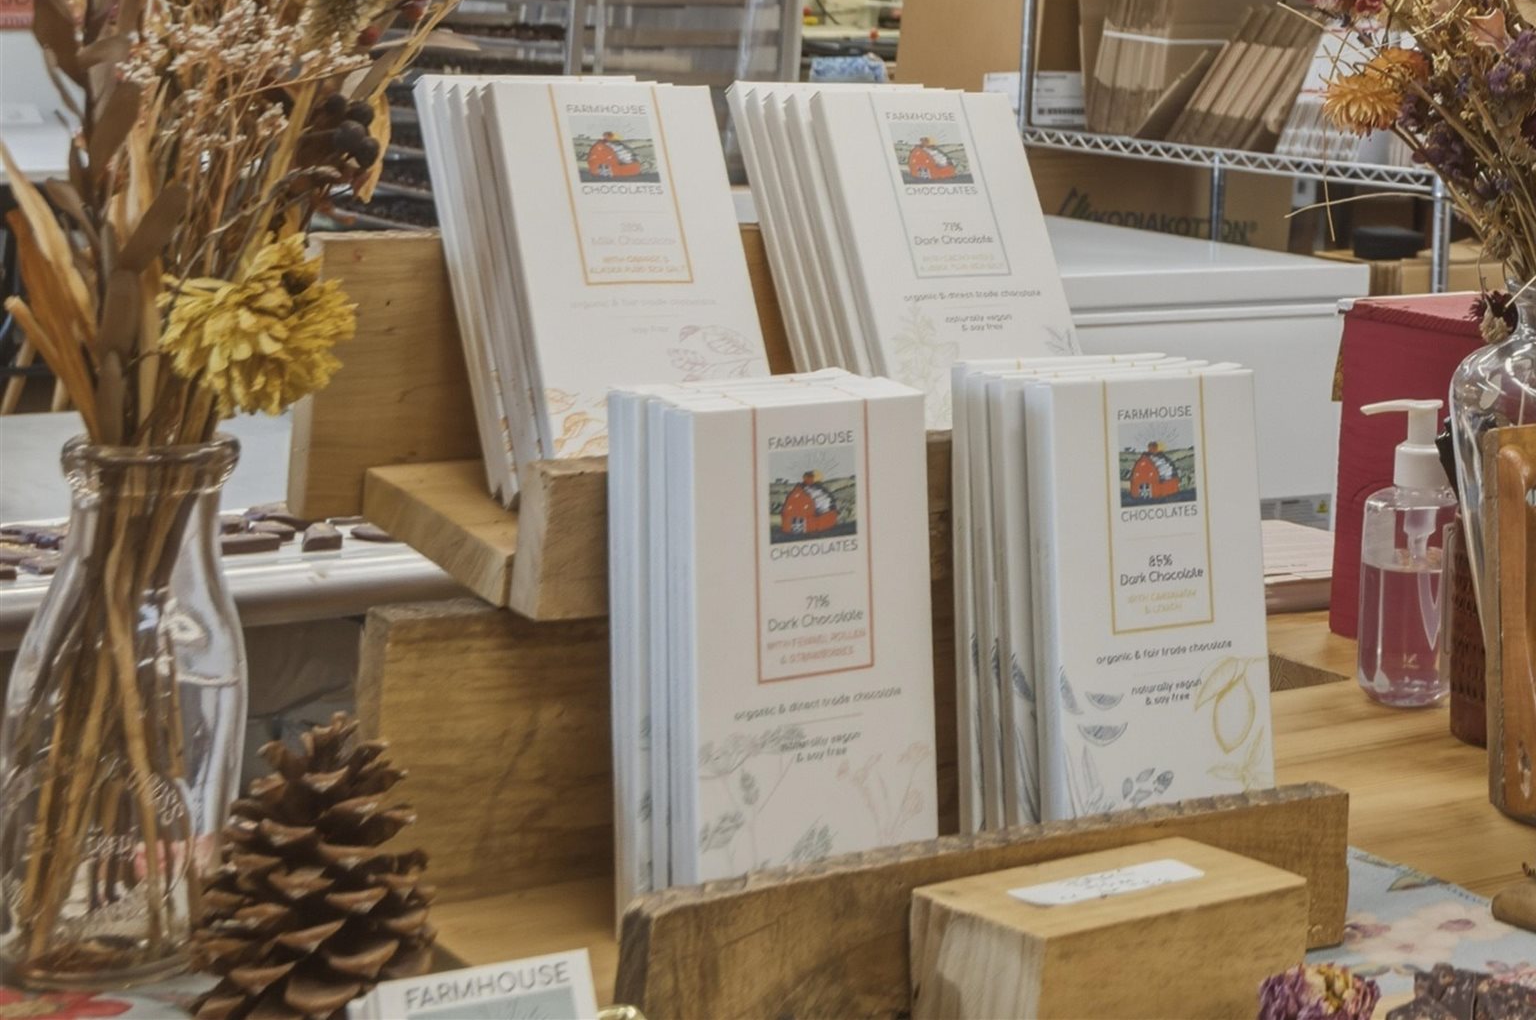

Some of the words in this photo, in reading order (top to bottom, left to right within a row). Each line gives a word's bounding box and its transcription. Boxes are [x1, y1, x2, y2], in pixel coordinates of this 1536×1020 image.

[566, 104, 647, 115] FARMHOUSE
[885, 111, 955, 122] FARMHOUSE
[581, 184, 664, 196] CHOCOLATES
[905, 186, 978, 196] CHOCOLATES
[914, 235, 939, 246] Dark
[941, 234, 994, 245] Chocolate
[1117, 405, 1192, 421] FARMHOUSE
[768, 430, 854, 451] FARMHOUSE
[1121, 505, 1198, 523] CHOCOLATES
[770, 538, 859, 561] CHOCOLATES
[1120, 572, 1147, 586] Dark
[1149, 567, 1204, 584] Chocolate
[768, 615, 798, 632] Dark
[801, 609, 864, 629] Chocolate
[1096, 652, 1133, 665] organic
[1143, 648, 1160, 659] fair
[1161, 645, 1187, 657] trade
[1131, 681, 1174, 696] naturally
[405, 960, 570, 1009] FARMHOUSE
